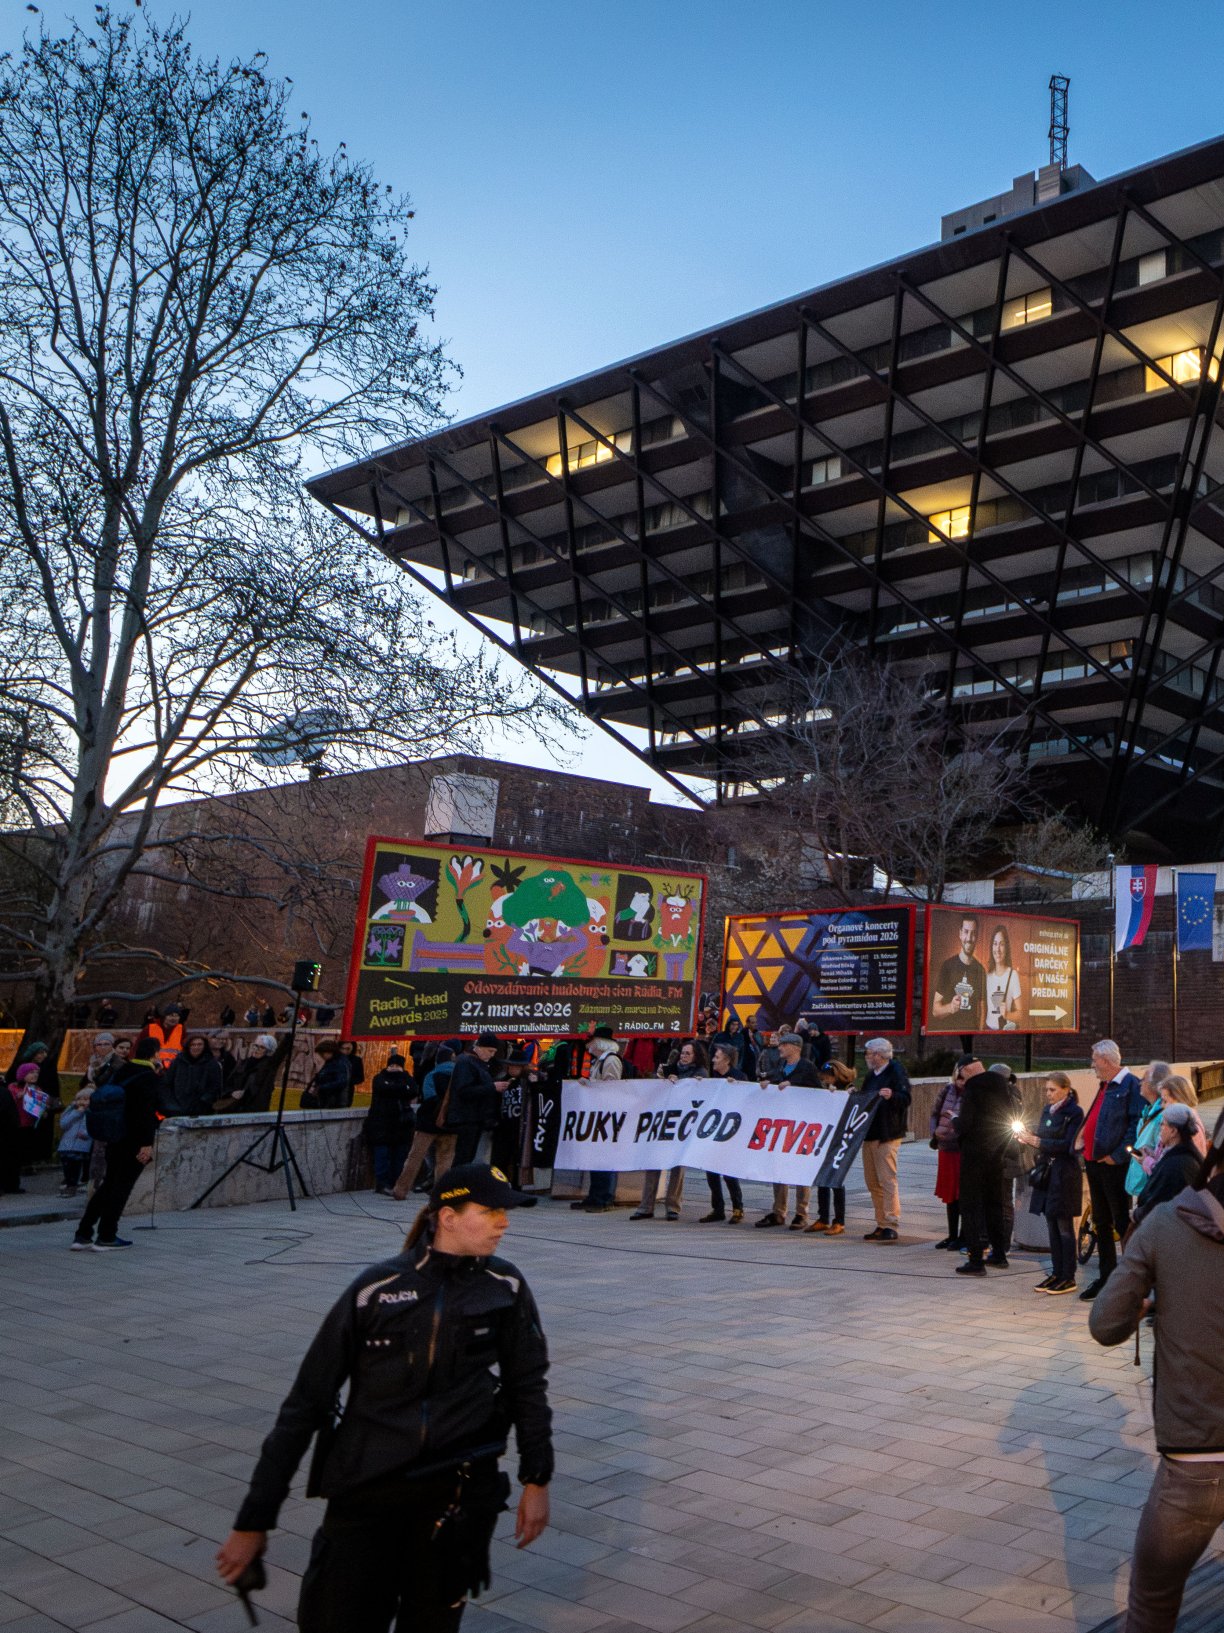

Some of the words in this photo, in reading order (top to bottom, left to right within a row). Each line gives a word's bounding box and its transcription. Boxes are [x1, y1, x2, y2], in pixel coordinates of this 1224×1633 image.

[828, 922, 864, 934] Organové
[865, 921, 899, 931] koncerty
[822, 934, 836, 946] pod
[880, 932, 899, 941] 2026
[1023, 942, 1069, 956] ORIGINÁLNE
[1034, 957, 1069, 970] DARČEKY
[1038, 973, 1044, 983] V
[1045, 971, 1068, 984] NAŠEJ
[464, 980, 550, 996] Odovzdávanie
[611, 985, 632, 997] cien
[1031, 987, 1068, 999] PREDAJNI
[369, 991, 448, 1013] Radio_Head
[461, 1001, 484, 1017] 27.
[487, 1003, 532, 1017] marec
[533, 1002, 572, 1017] 2026
[369, 1011, 423, 1029] Awards
[424, 1009, 448, 1022] 2025
[479, 1024, 507, 1034] prenos
[562, 1110, 627, 1143] RUKY
